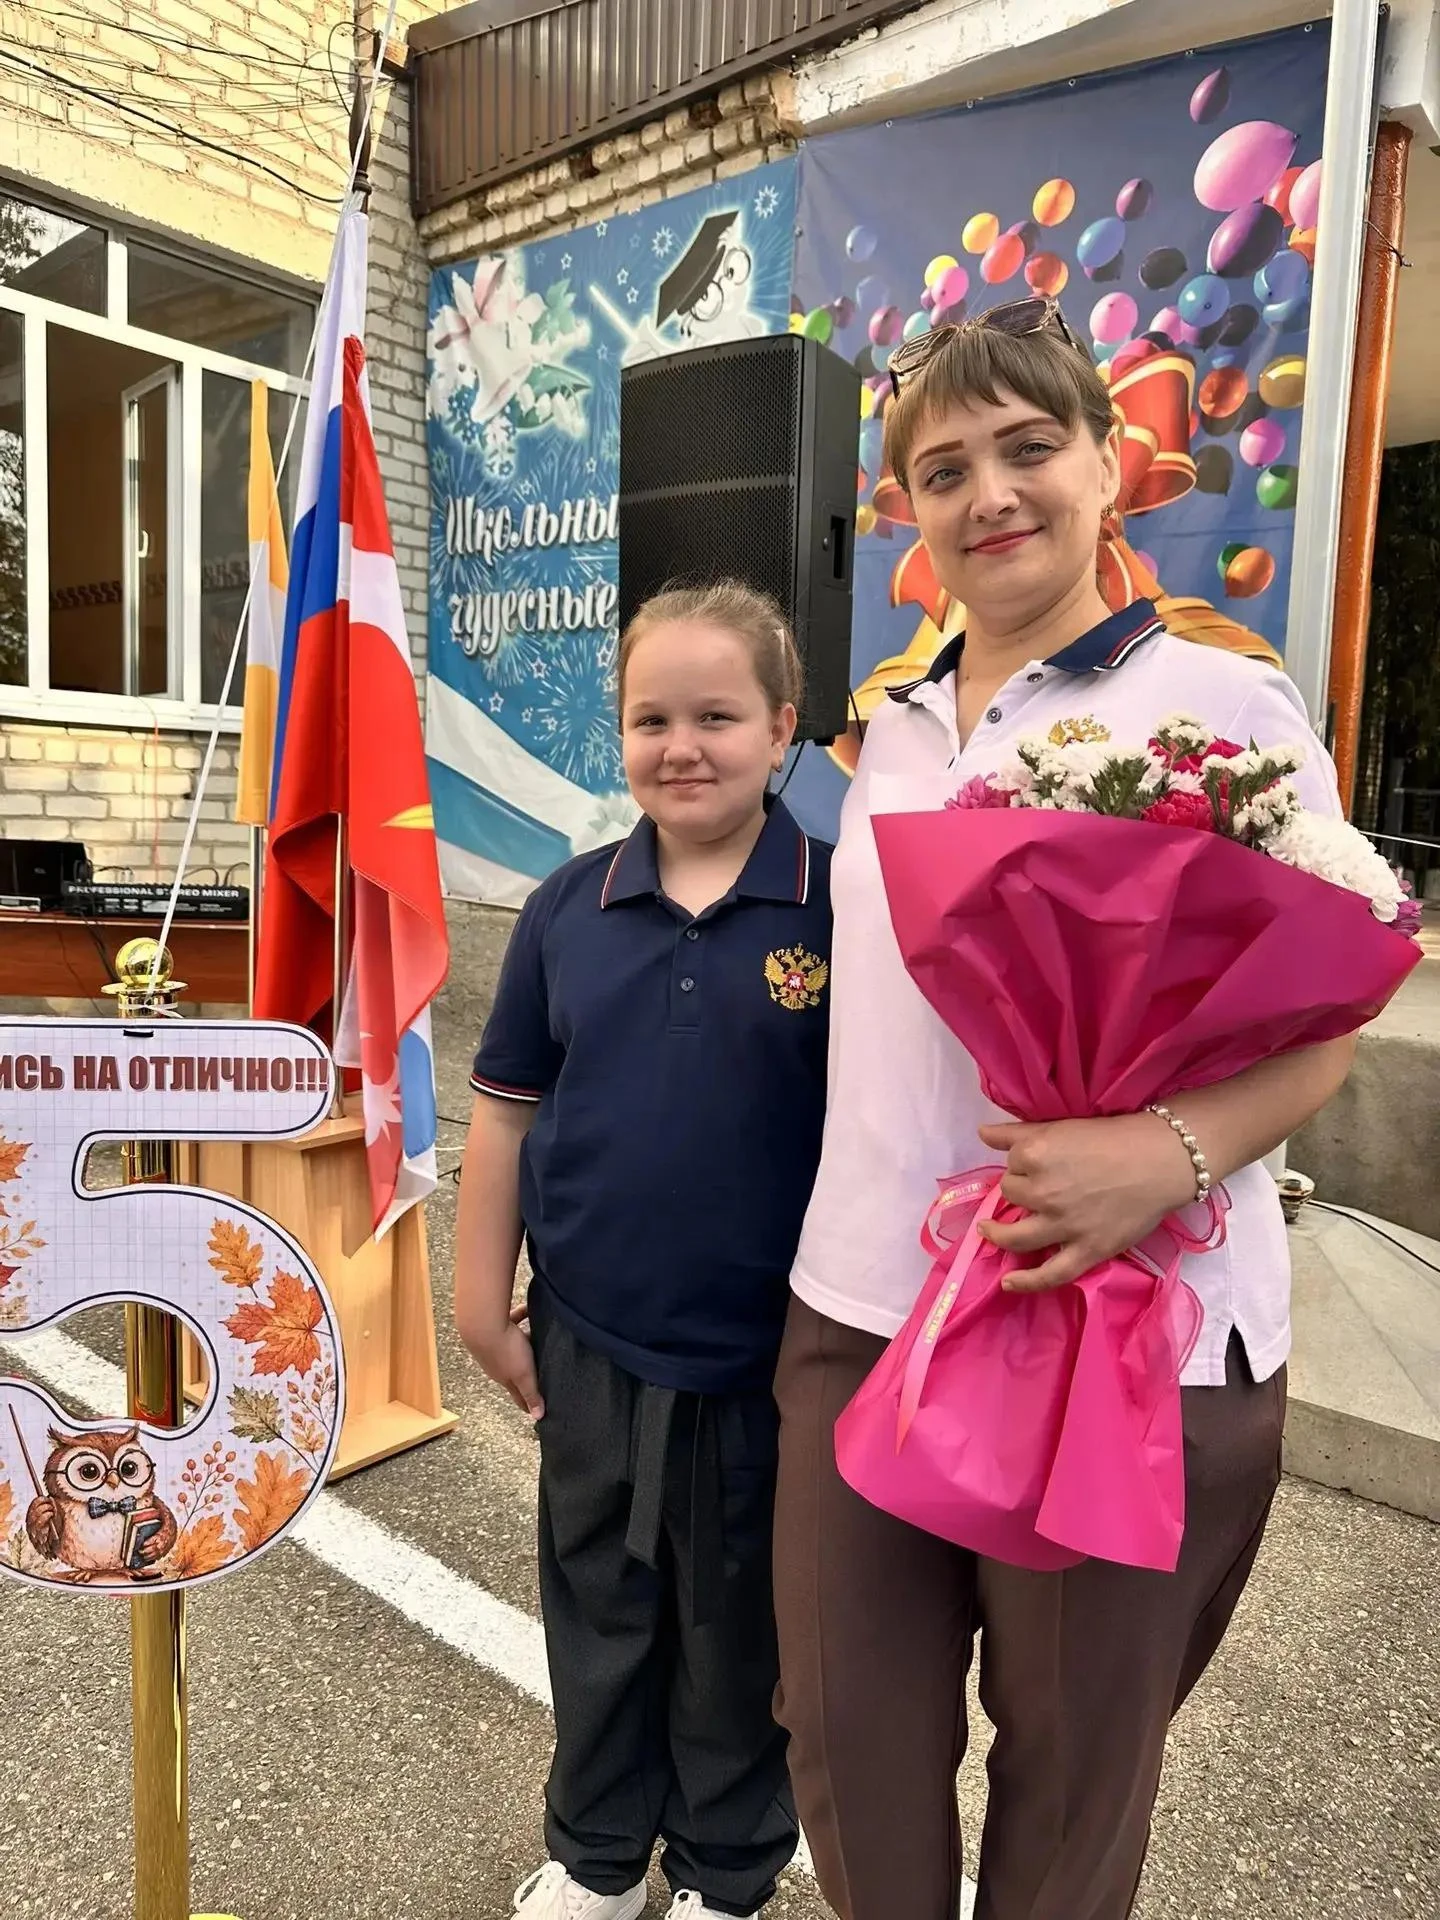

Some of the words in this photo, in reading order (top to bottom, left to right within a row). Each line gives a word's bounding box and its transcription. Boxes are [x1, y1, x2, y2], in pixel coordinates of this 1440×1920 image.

[448, 583, 617, 655] чудесные
[156, 887, 200, 897] SREO
[202, 889, 239, 898] MIXER
[73, 1055, 120, 1091] НА
[129, 1056, 329, 1092] ОТЛИЧНО!!!
